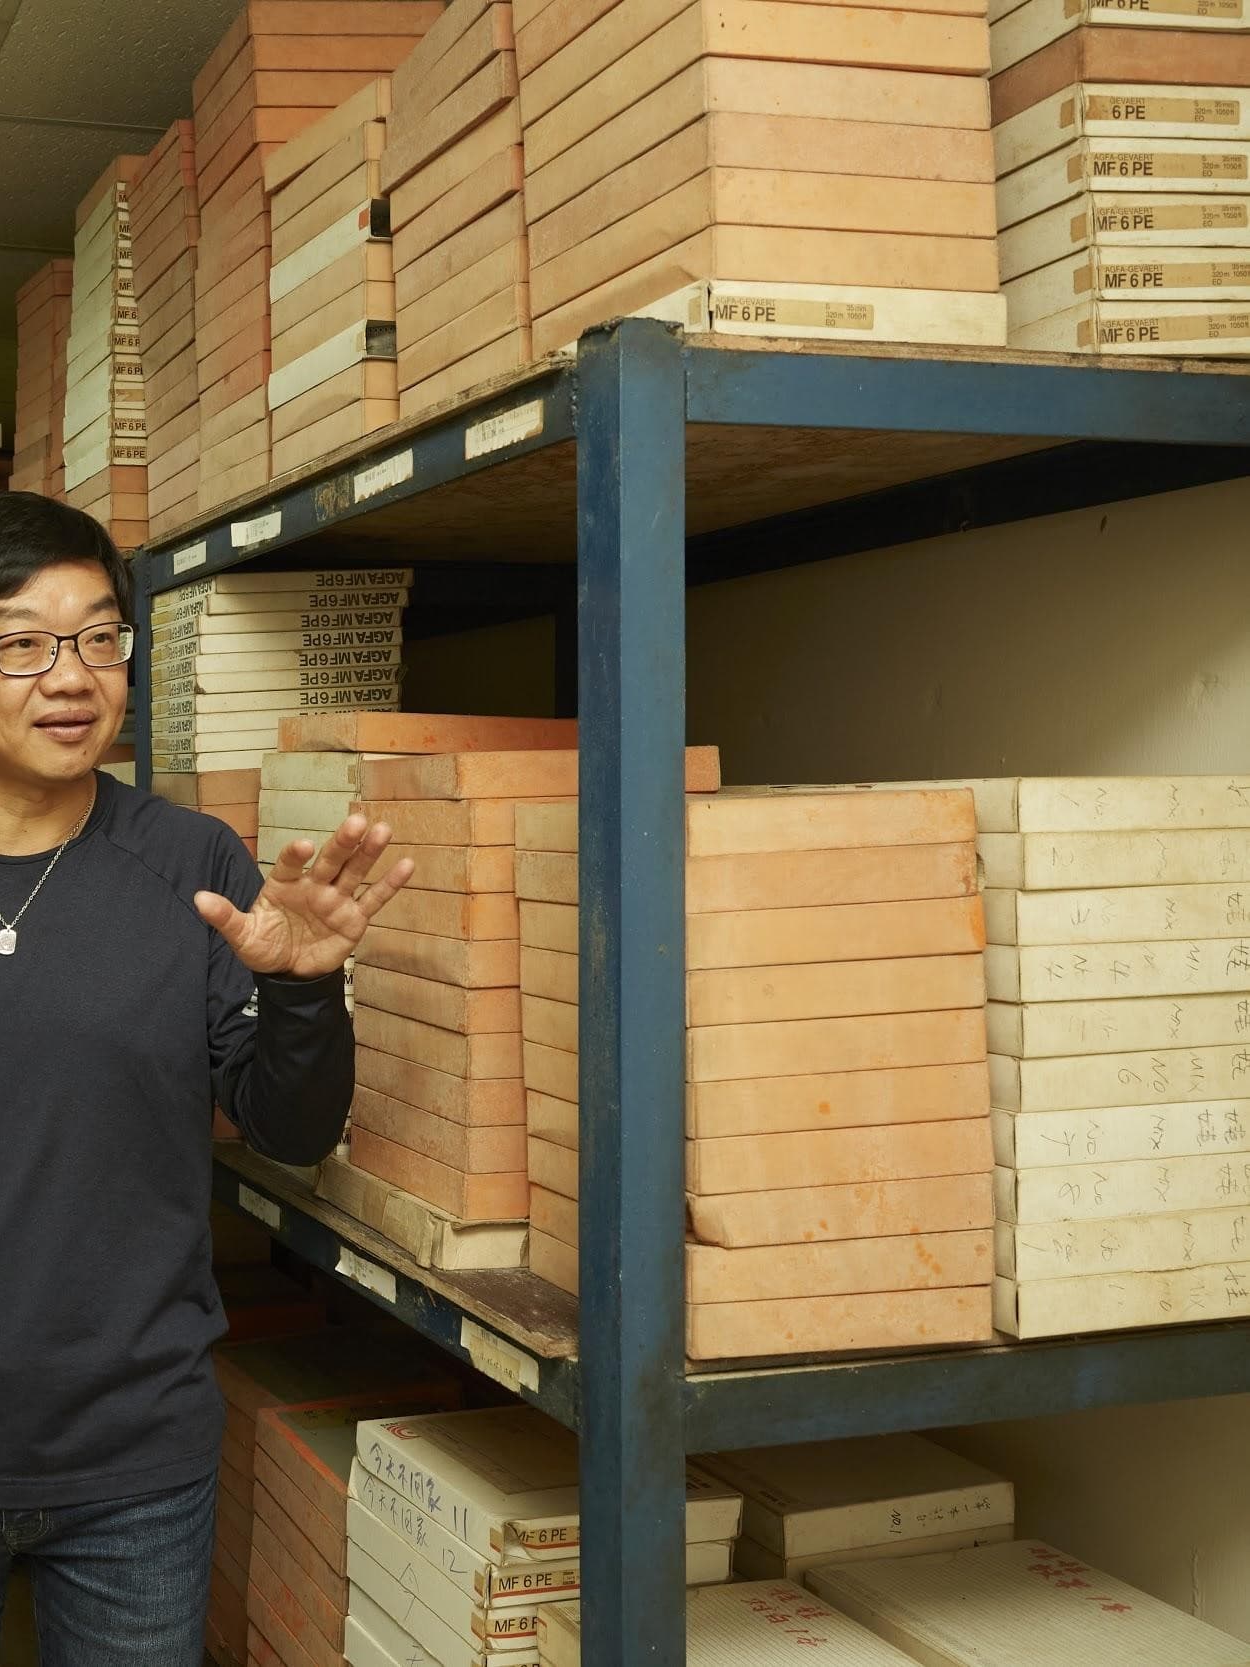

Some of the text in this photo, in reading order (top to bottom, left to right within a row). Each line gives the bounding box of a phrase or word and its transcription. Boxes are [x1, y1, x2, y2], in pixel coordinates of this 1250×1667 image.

[1129, 0, 1150, 10] PE
[1112, 105, 1146, 120] 6 PE
[1093, 153, 1154, 161] AGFA-GEVAERT
[1094, 161, 1153, 176] MF 6 PE
[1097, 214, 1154, 230] MF 6 PE
[1105, 264, 1163, 273] AGFA-GEVAERT
[1105, 272, 1163, 288] MF 6 PE
[715, 304, 776, 322] MF 6 PE
[1100, 326, 1160, 343] MF 6 PE
[114, 422, 127, 430] MF
[113, 450, 125, 458] MF
[134, 450, 145, 459] PE
[366, 572, 405, 585] AGFA
[361, 592, 400, 605] AGFA
[354, 611, 394, 625] AGFA
[355, 630, 394, 644] AGFA
[352, 650, 392, 664] AGFA
[353, 668, 393, 682] AGFA
[352, 688, 393, 702] AGFA
[1117, 1068, 1142, 1084] 6
[540, 1530, 548, 1543] 6
[551, 1529, 567, 1542] PE
[441, 1547, 468, 1574] 12
[498, 1573, 552, 1591] MF 6 PE
[494, 1619, 515, 1633] MF
[519, 1617, 528, 1632] 6
